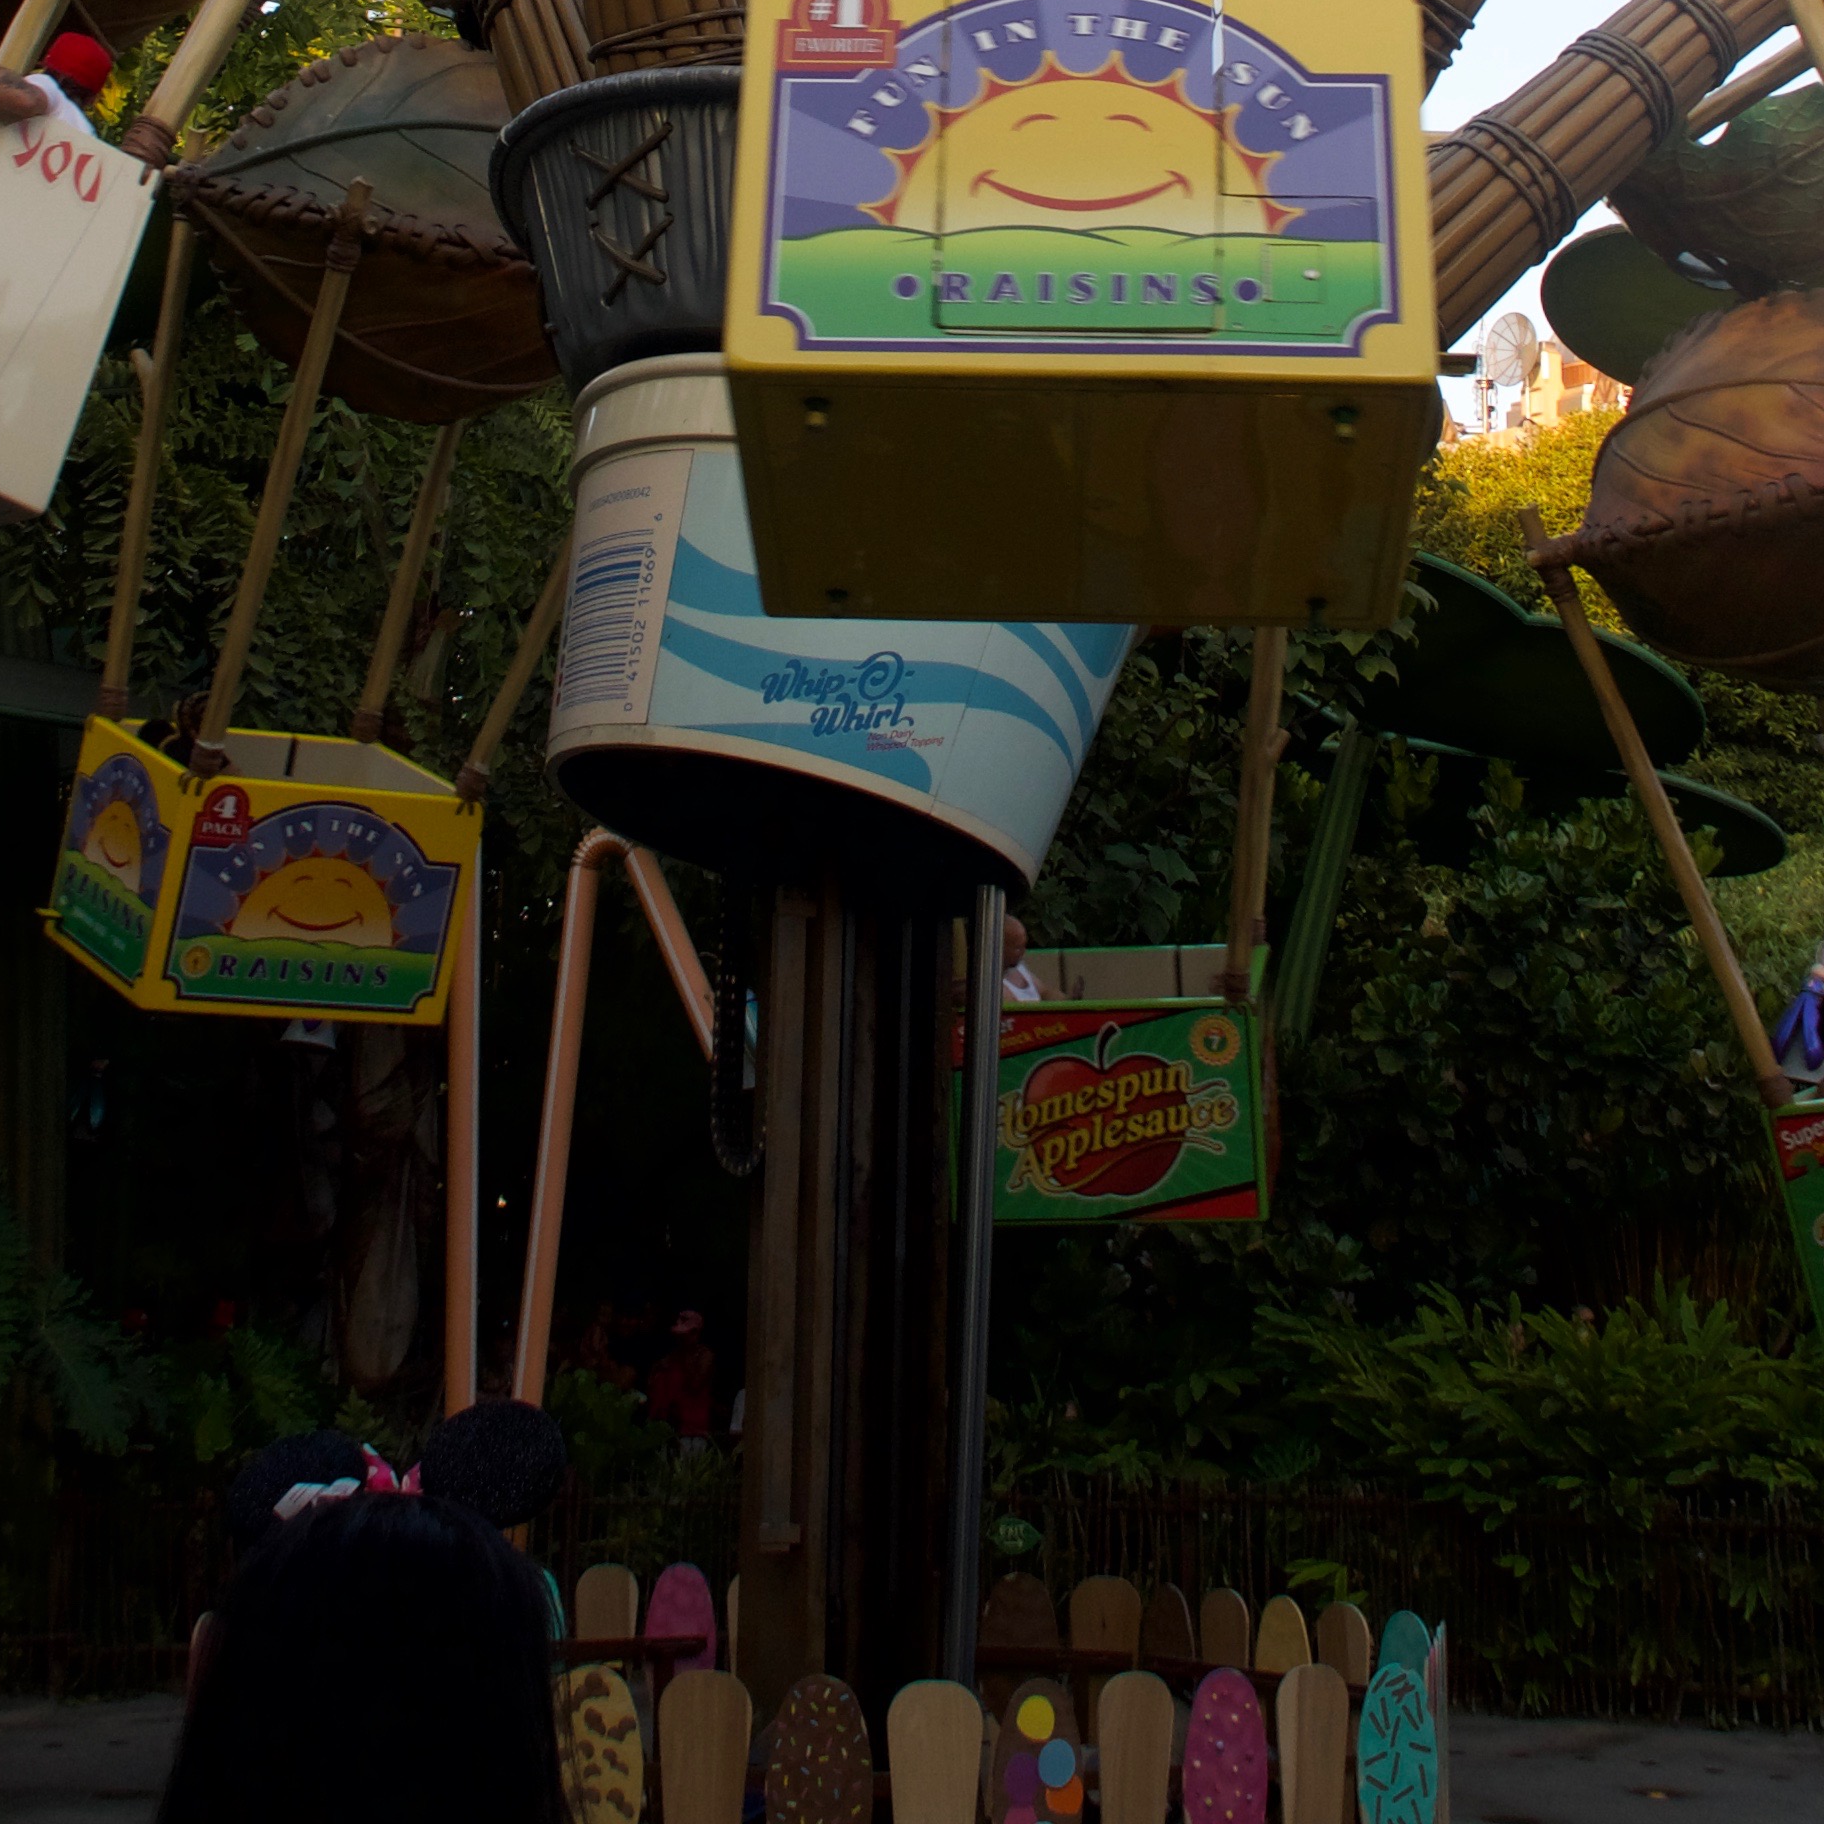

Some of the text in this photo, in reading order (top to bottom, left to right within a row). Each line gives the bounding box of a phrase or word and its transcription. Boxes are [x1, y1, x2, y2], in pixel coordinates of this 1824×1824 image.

[846, 13, 1319, 142] FUN IN THE SUN
[12, 119, 102, 203] YOU
[938, 272, 1222, 305] RAISINS
[637, 547, 657, 607] 11669
[627, 619, 648, 682] 41502
[810, 693, 914, 737] Whirl
[201, 822, 243, 836] PACK
[212, 795, 238, 820] 4
[284, 821, 313, 837] IN
[330, 819, 380, 843] THE
[218, 955, 390, 986] RAISINS
[1007, 1096, 1236, 1191] Applesauce
